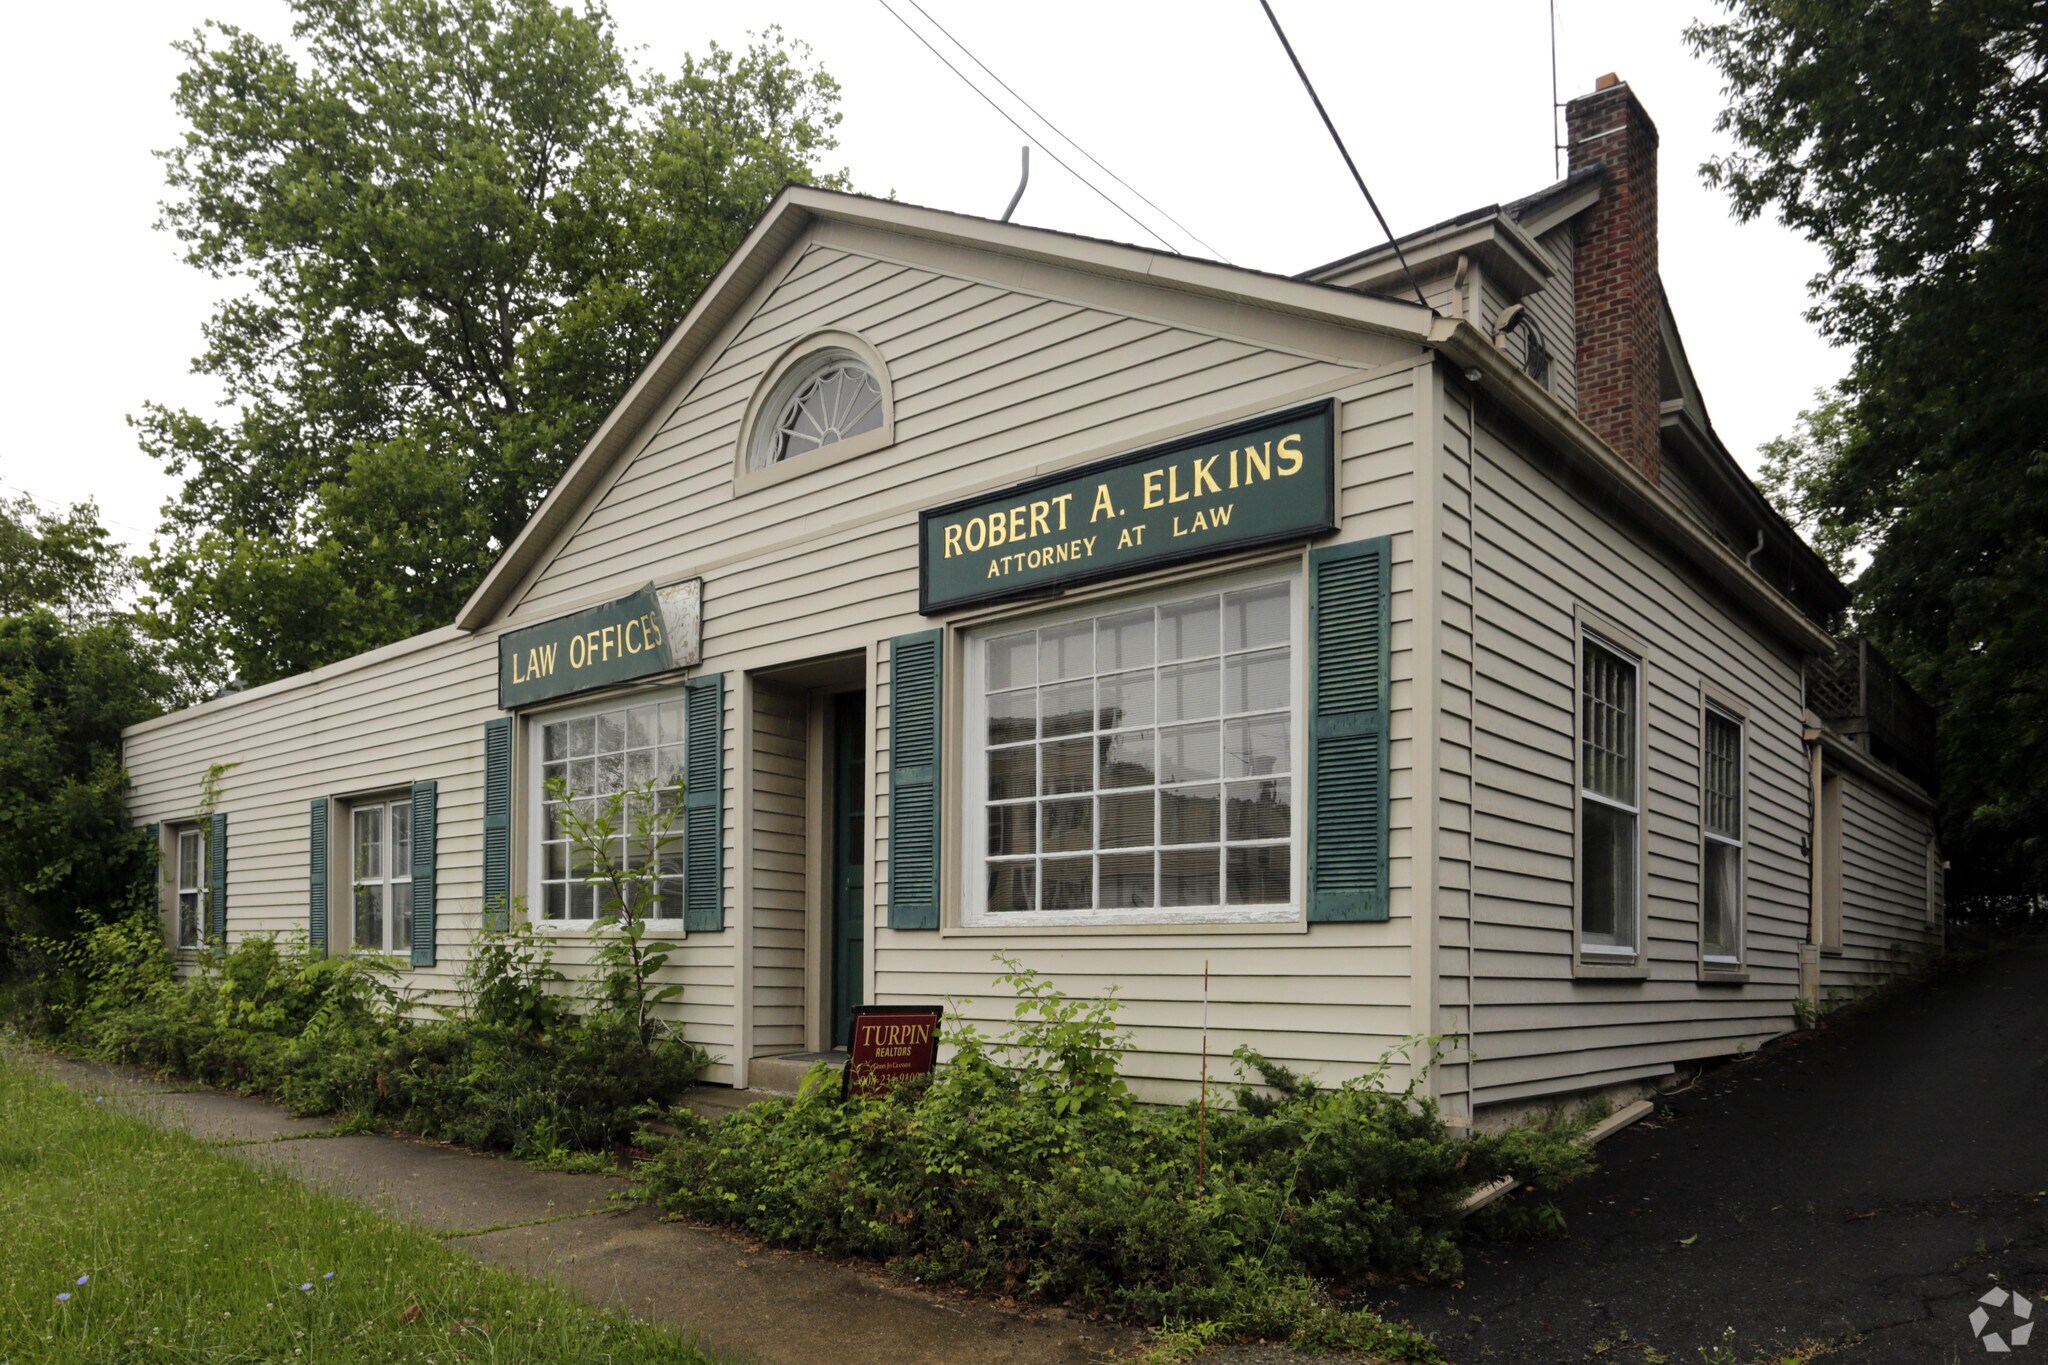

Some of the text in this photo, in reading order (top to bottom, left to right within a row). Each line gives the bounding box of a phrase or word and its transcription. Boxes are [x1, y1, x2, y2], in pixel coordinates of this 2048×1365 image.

[943, 433, 1304, 560] ROBERT A. ELKINS
[987, 503, 1235, 579] ATTORNEY AT LAW
[512, 610, 663, 685] LAW OFFICES
[862, 1024, 931, 1047] TURPIN
[875, 1046, 912, 1058] REALTORS
